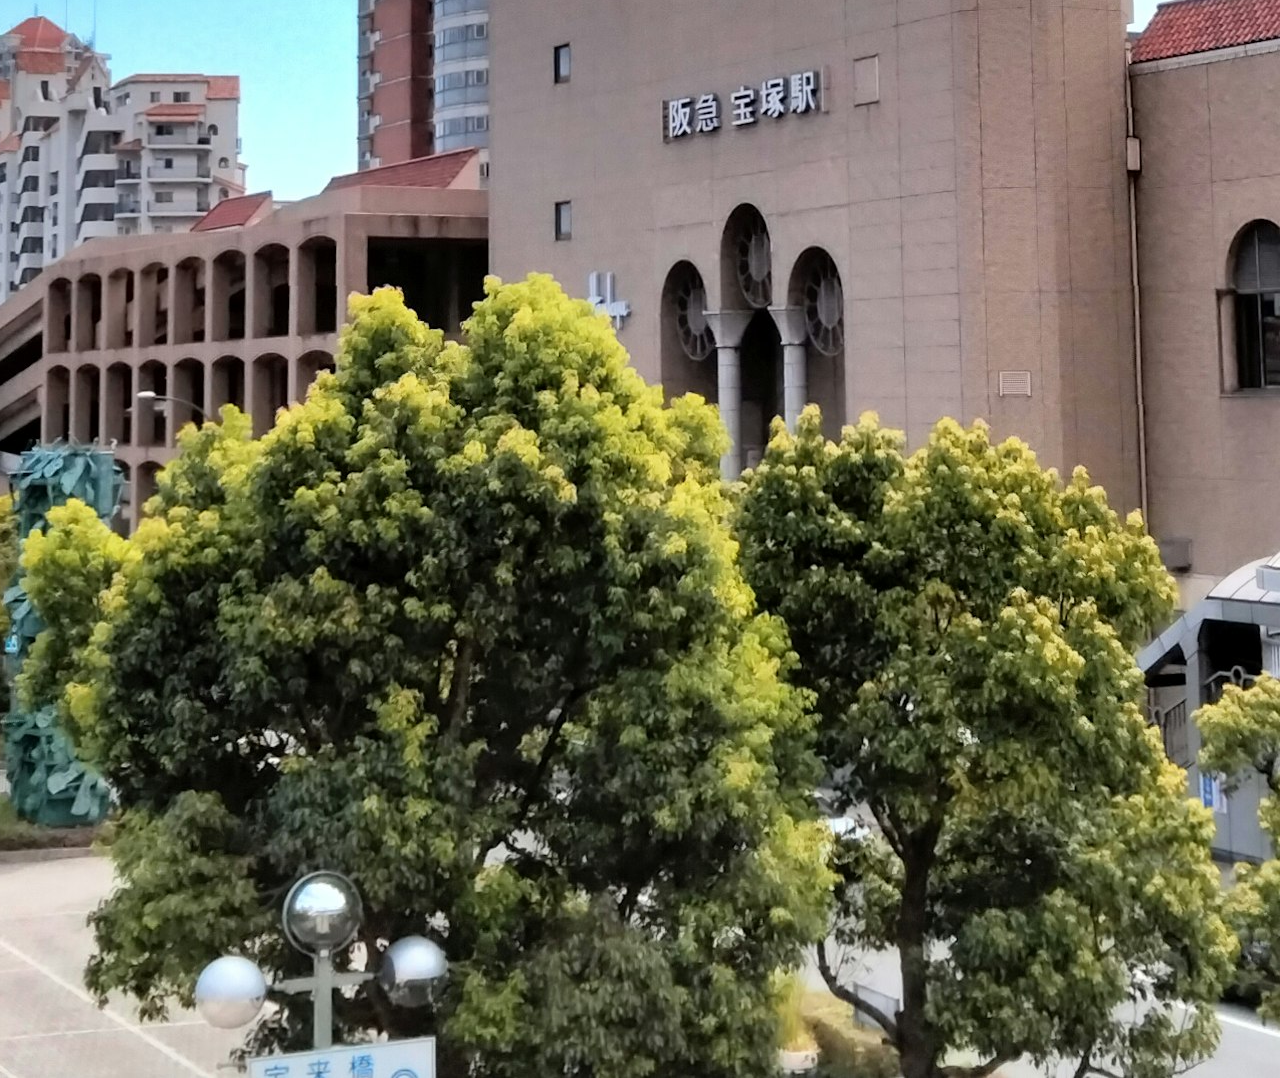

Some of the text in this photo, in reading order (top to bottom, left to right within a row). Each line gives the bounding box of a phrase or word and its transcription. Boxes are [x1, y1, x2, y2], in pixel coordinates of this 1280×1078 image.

[669, 71, 816, 138] 阪急 宝塚駅
